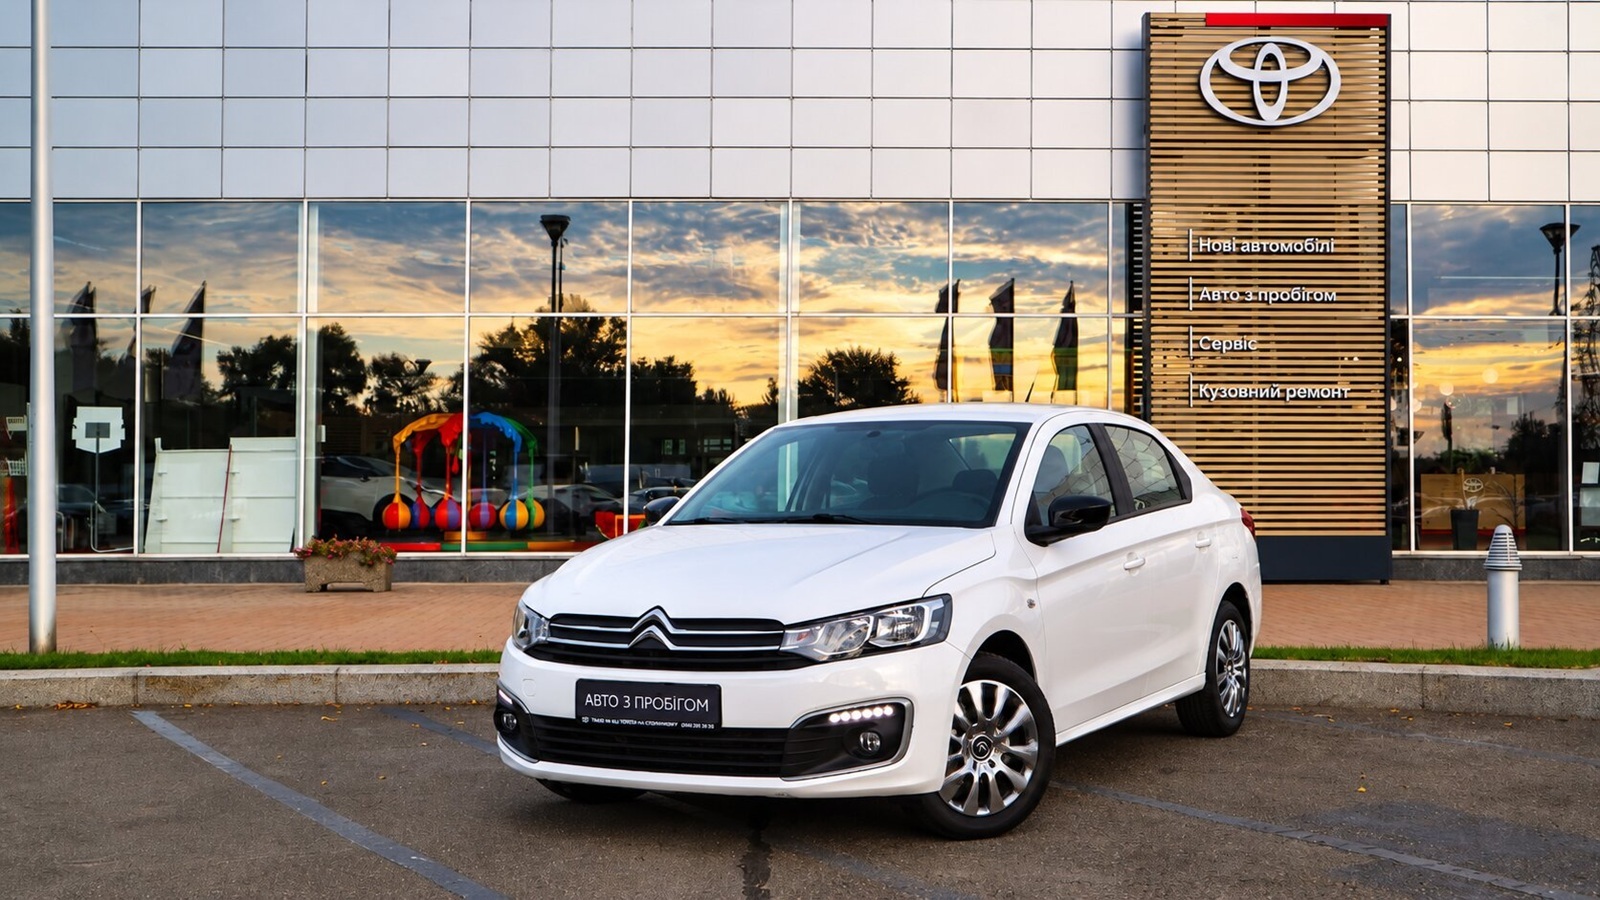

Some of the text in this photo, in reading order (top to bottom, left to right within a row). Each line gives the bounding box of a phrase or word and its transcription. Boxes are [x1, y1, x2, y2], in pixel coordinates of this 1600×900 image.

[1199, 236, 1335, 253] Нові автомобілі
[1199, 286, 1337, 304] Авто з пробігом
[1199, 335, 1257, 353] Сервіс
[1199, 383, 1351, 402] Кузовний ремонт
[584, 693, 619, 708] АВТО
